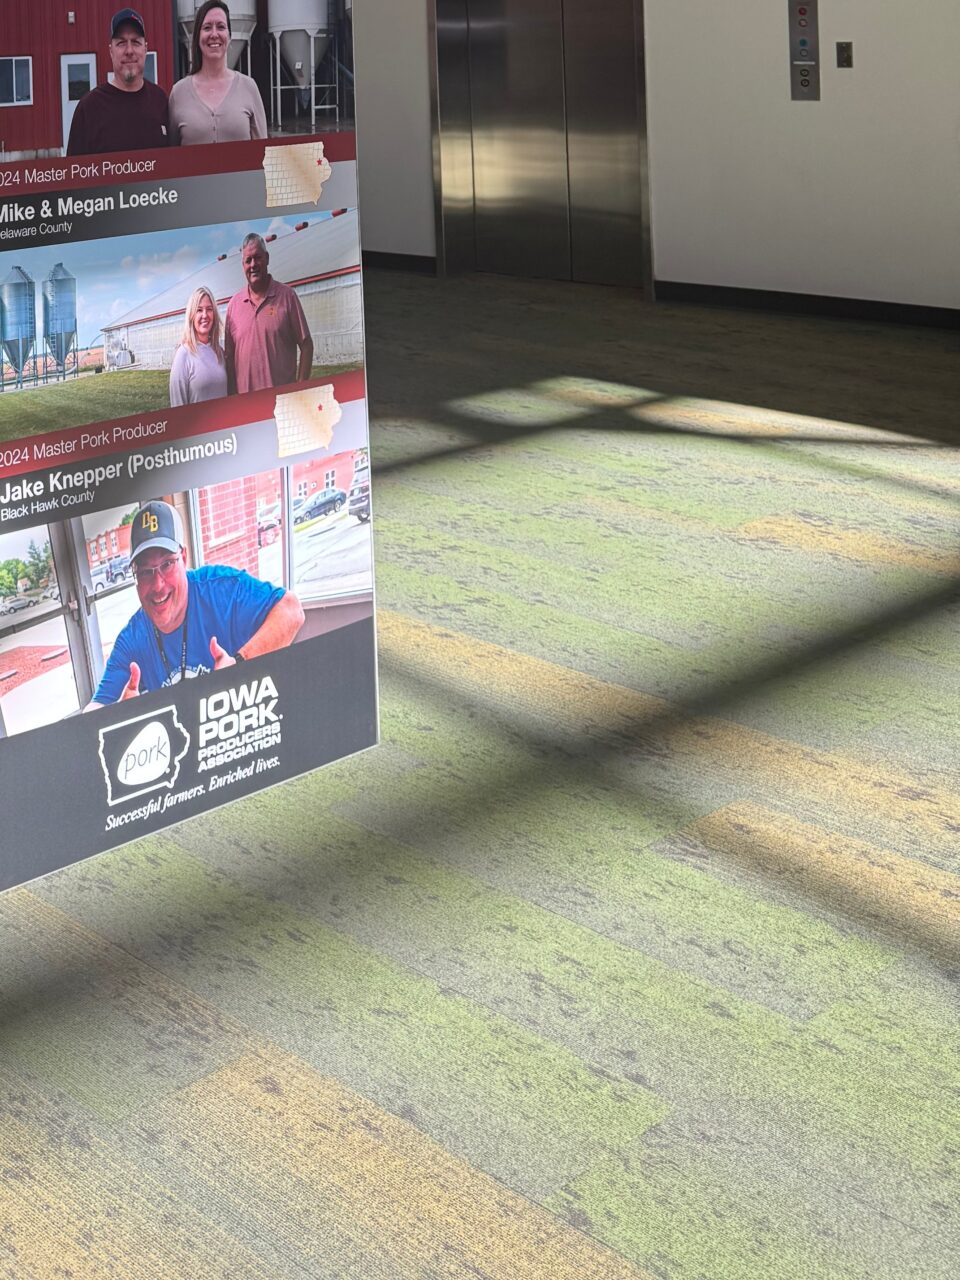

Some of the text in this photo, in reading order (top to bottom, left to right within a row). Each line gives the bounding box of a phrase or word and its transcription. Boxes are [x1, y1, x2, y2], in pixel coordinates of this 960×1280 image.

[25, 168, 67, 184] Master
[71, 163, 99, 179] Pork
[102, 159, 156, 176] Producer
[40, 199, 53, 218] &
[58, 196, 114, 217] Megan
[120, 187, 178, 209] Loecke
[39, 221, 72, 234] County
[33, 438, 77, 461] Master
[81, 431, 109, 450] Pork
[113, 420, 168, 443] Producer
[0, 433, 237, 504] Jake Knepper (Posthumous)
[0, 489, 95, 522] Black Hawk County
[199, 676, 278, 723] IOWA
[125, 736, 167, 780] pork
[198, 722, 280, 761] PRODUCERS
[198, 733, 281, 773] ASSOCIATION
[105, 756, 280, 831] Successful farmers. Enriched lives.
